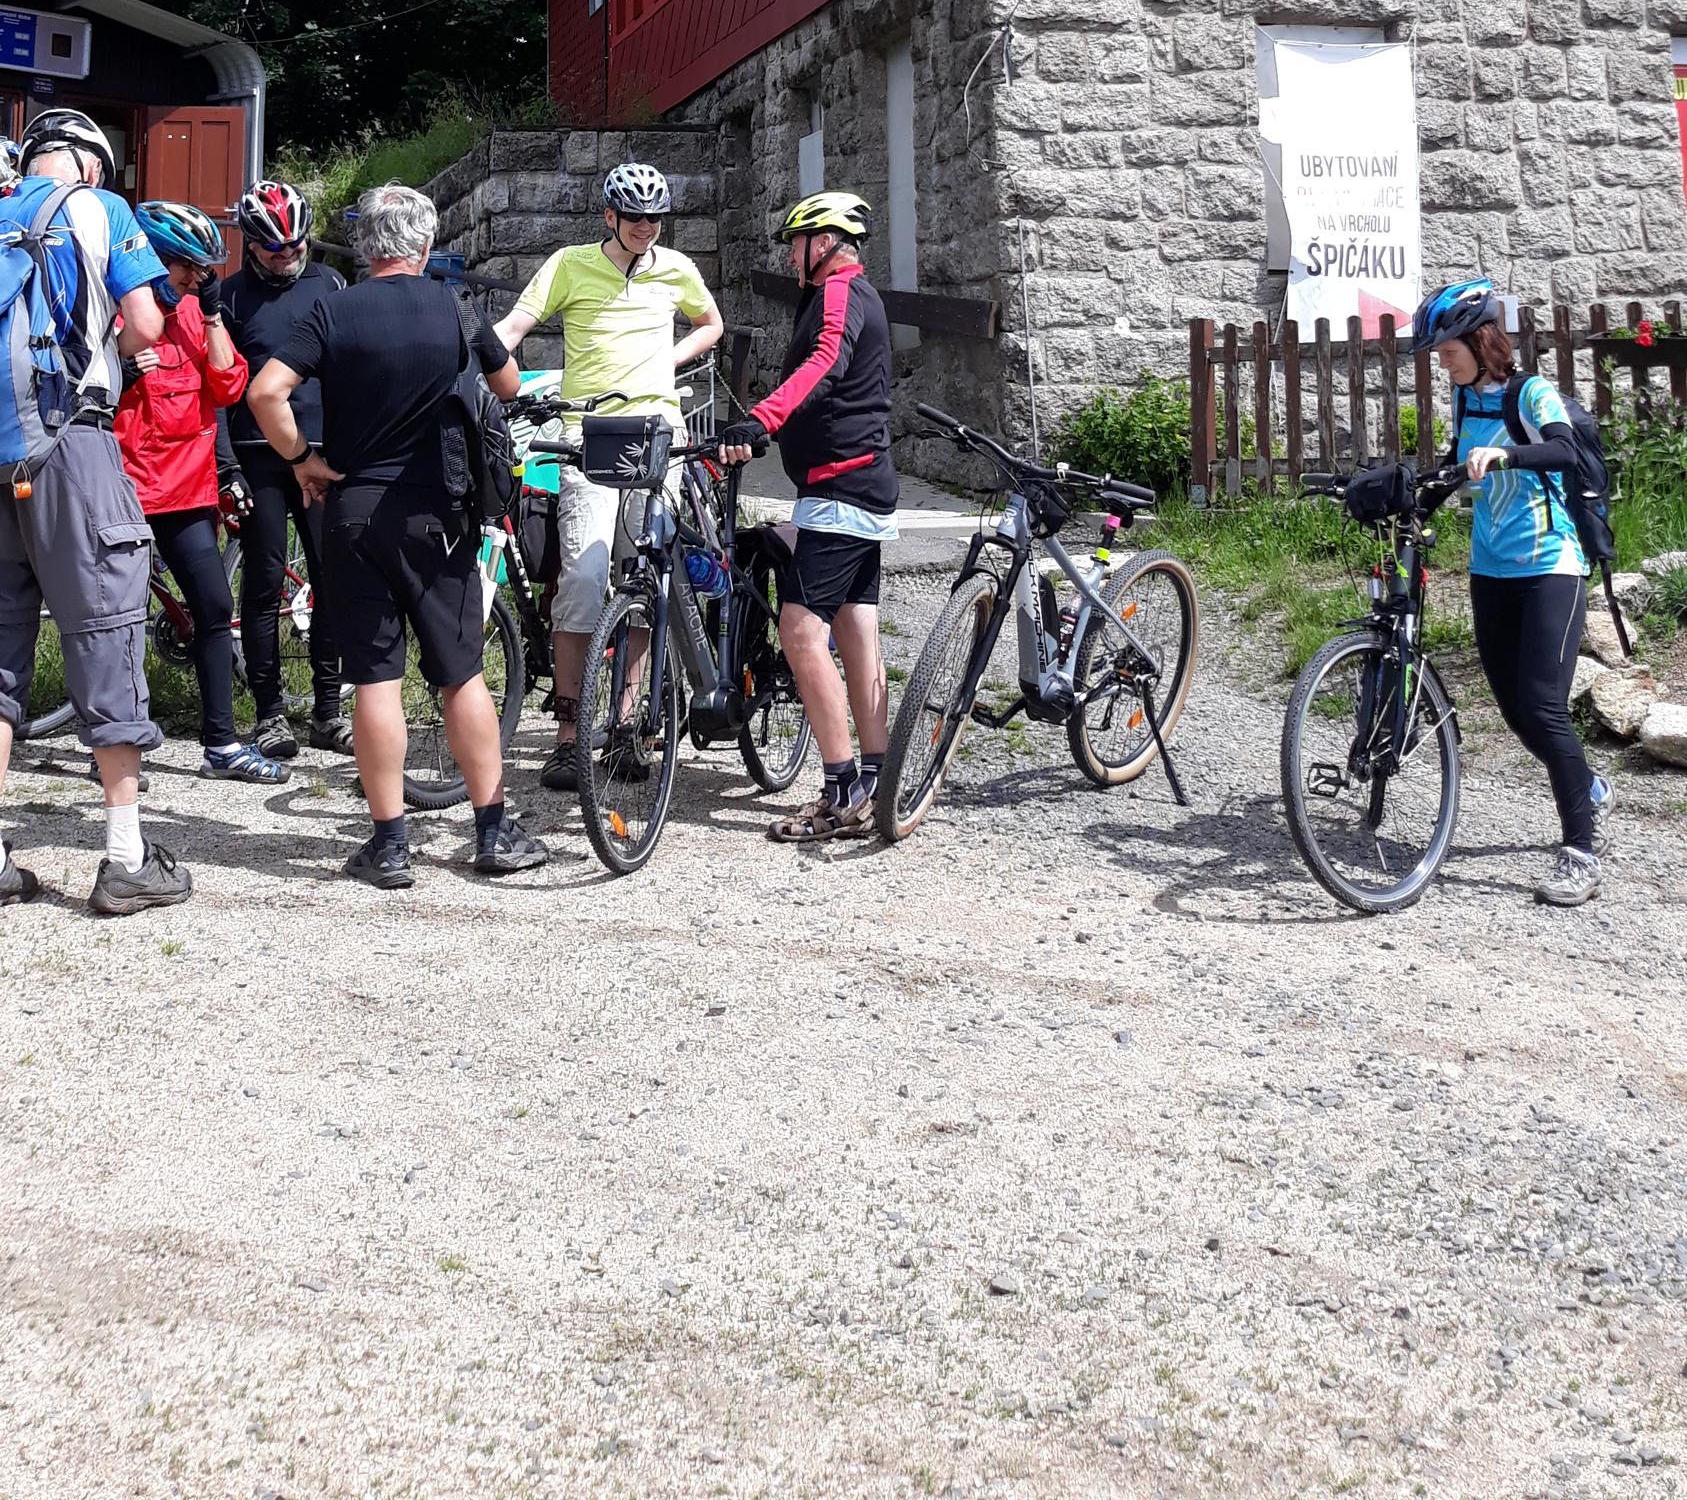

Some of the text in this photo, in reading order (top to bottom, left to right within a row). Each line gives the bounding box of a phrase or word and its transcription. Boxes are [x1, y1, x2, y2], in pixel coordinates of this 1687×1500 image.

[1300, 150, 1398, 177] UBYTOVÁNÍ
[1317, 214, 1391, 233] NA VRCHOLU
[1306, 235, 1405, 279] ŠPIČÁKU
[679, 583, 710, 651] APACHE
[1031, 591, 1047, 673] MACHINE
